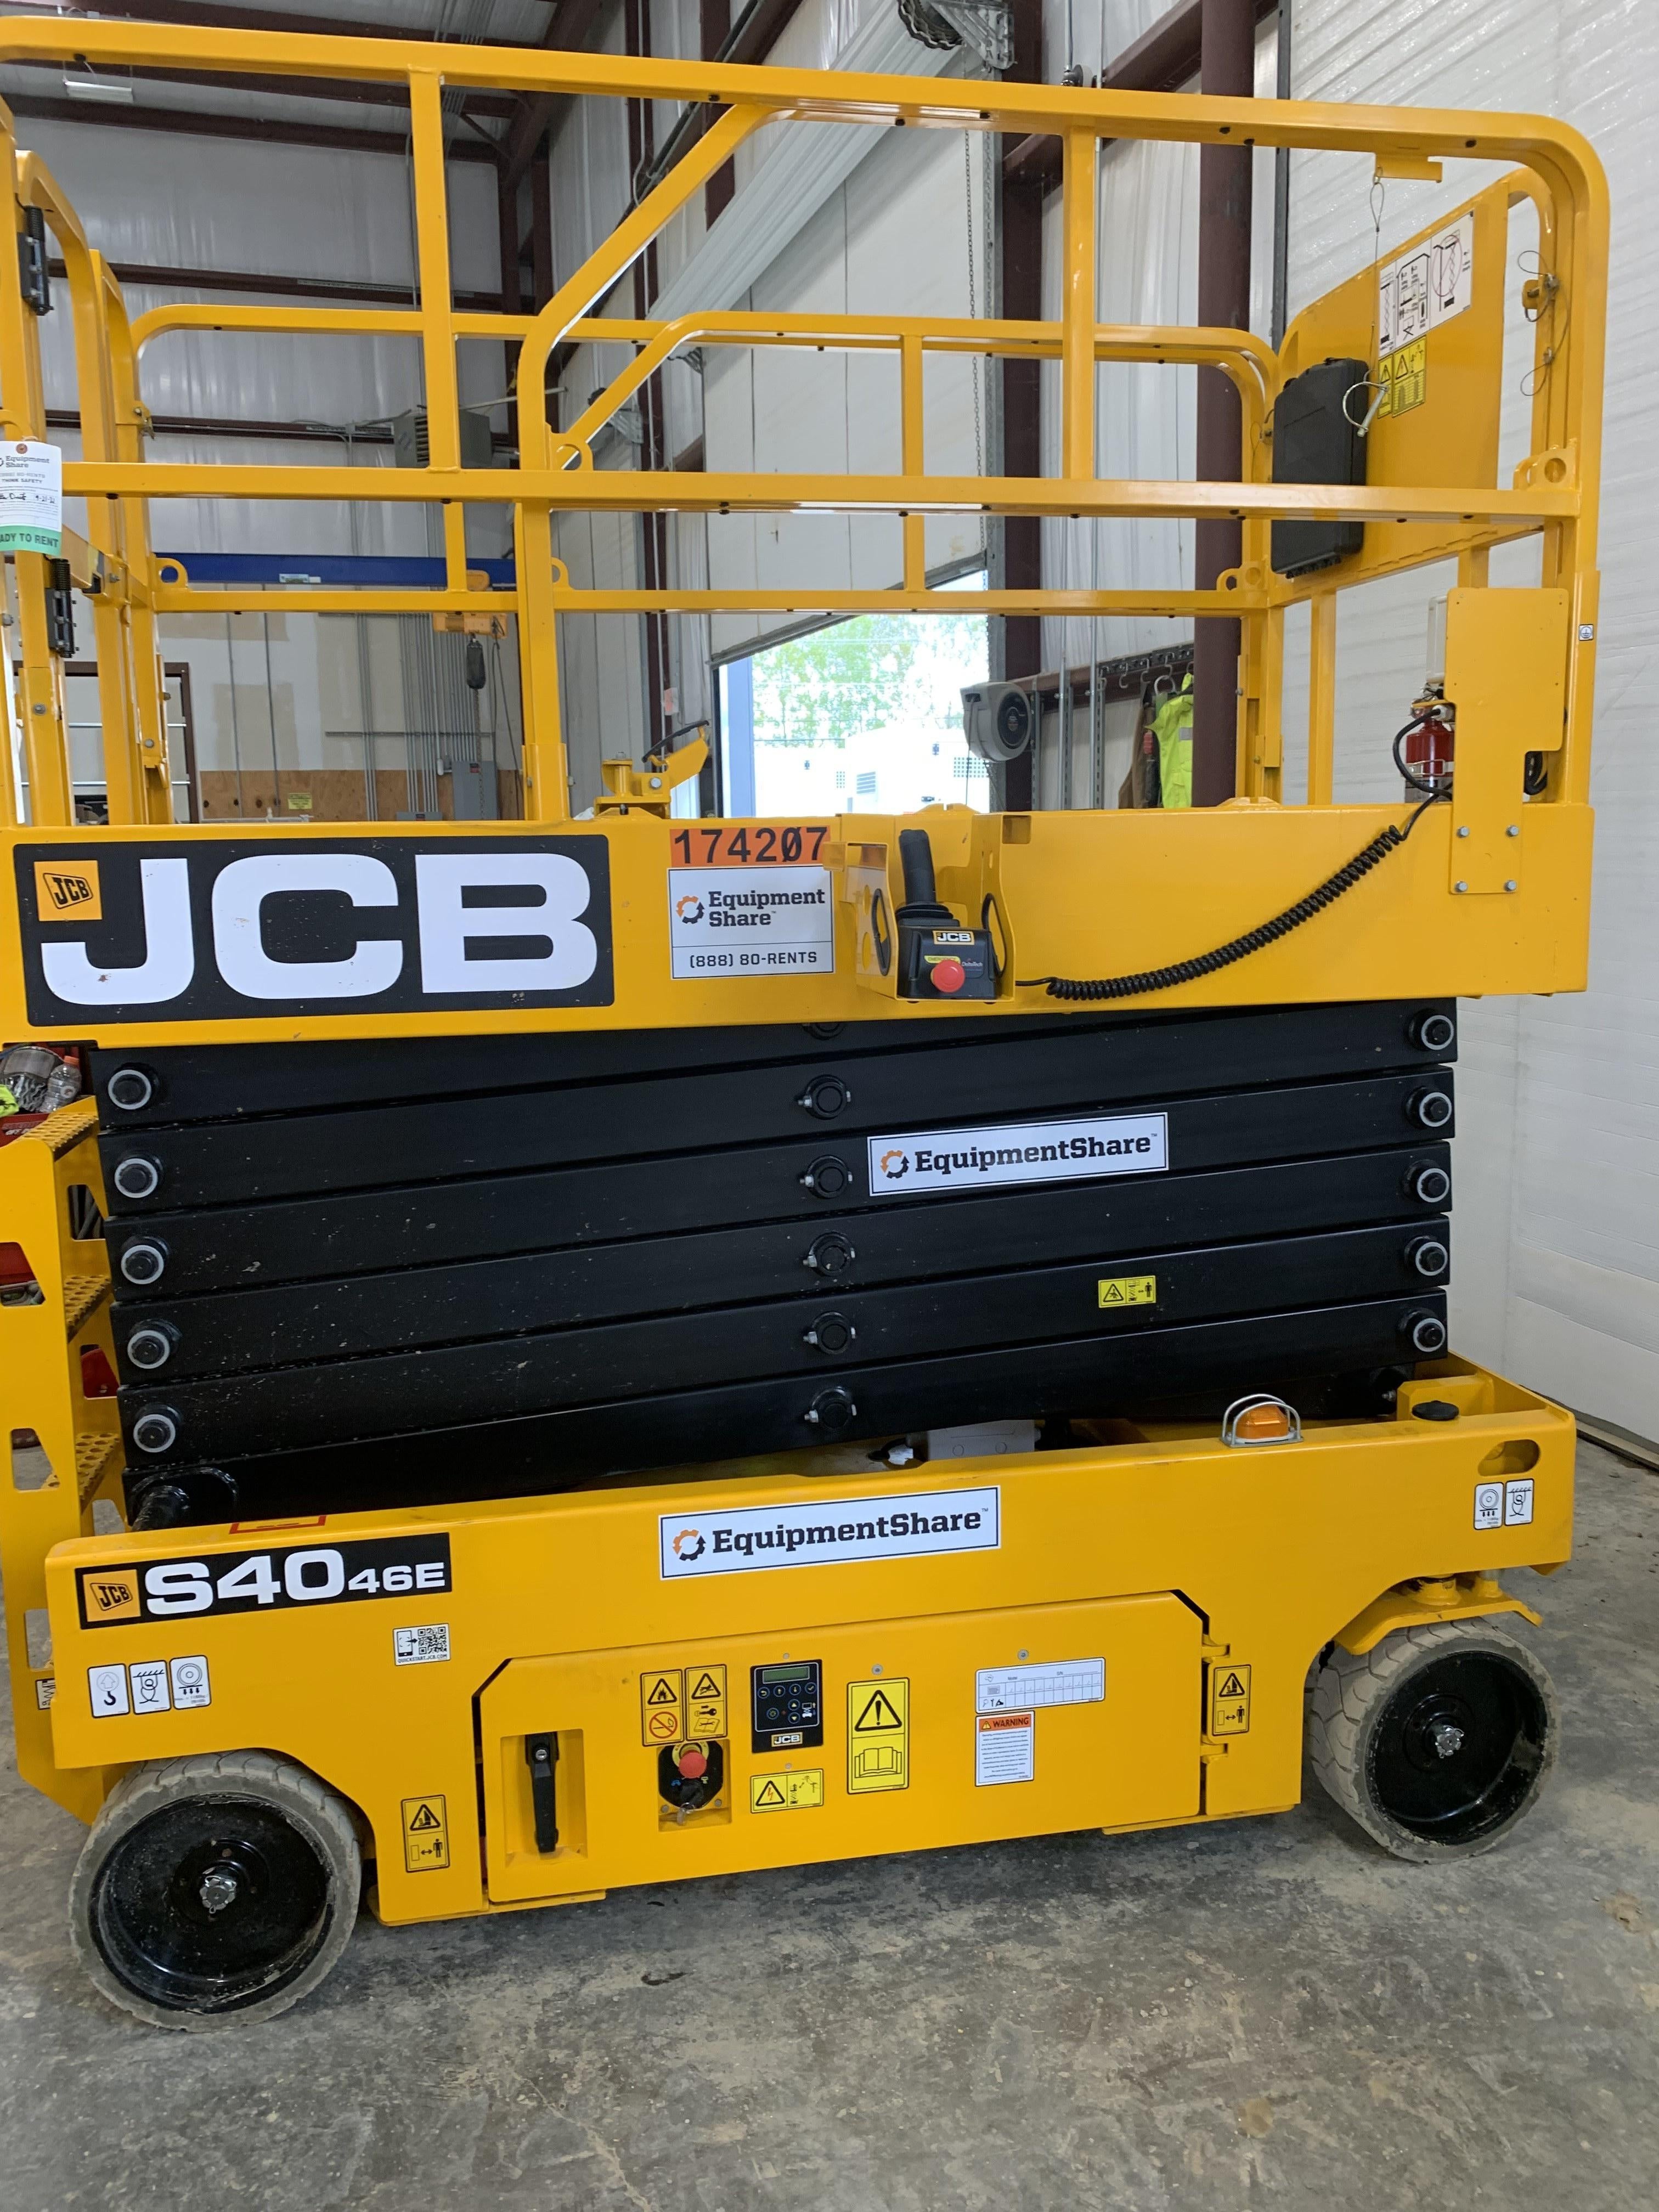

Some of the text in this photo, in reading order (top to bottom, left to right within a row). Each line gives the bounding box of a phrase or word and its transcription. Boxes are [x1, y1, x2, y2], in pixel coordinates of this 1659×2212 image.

[20, 533, 32, 542] TO
[35, 534, 58, 548] RENT
[675, 827, 827, 864] 174207
[52, 877, 89, 905] JCB
[708, 889, 825, 910] Equipment
[41, 853, 598, 1005] JCB
[937, 933, 971, 941] JCB
[690, 951, 817, 968] (888) 80-RENTS
[98, 1585, 130, 1607] JCB
[992, 1717, 1029, 1728] WARNING
[774, 1735, 800, 1744] JCB
